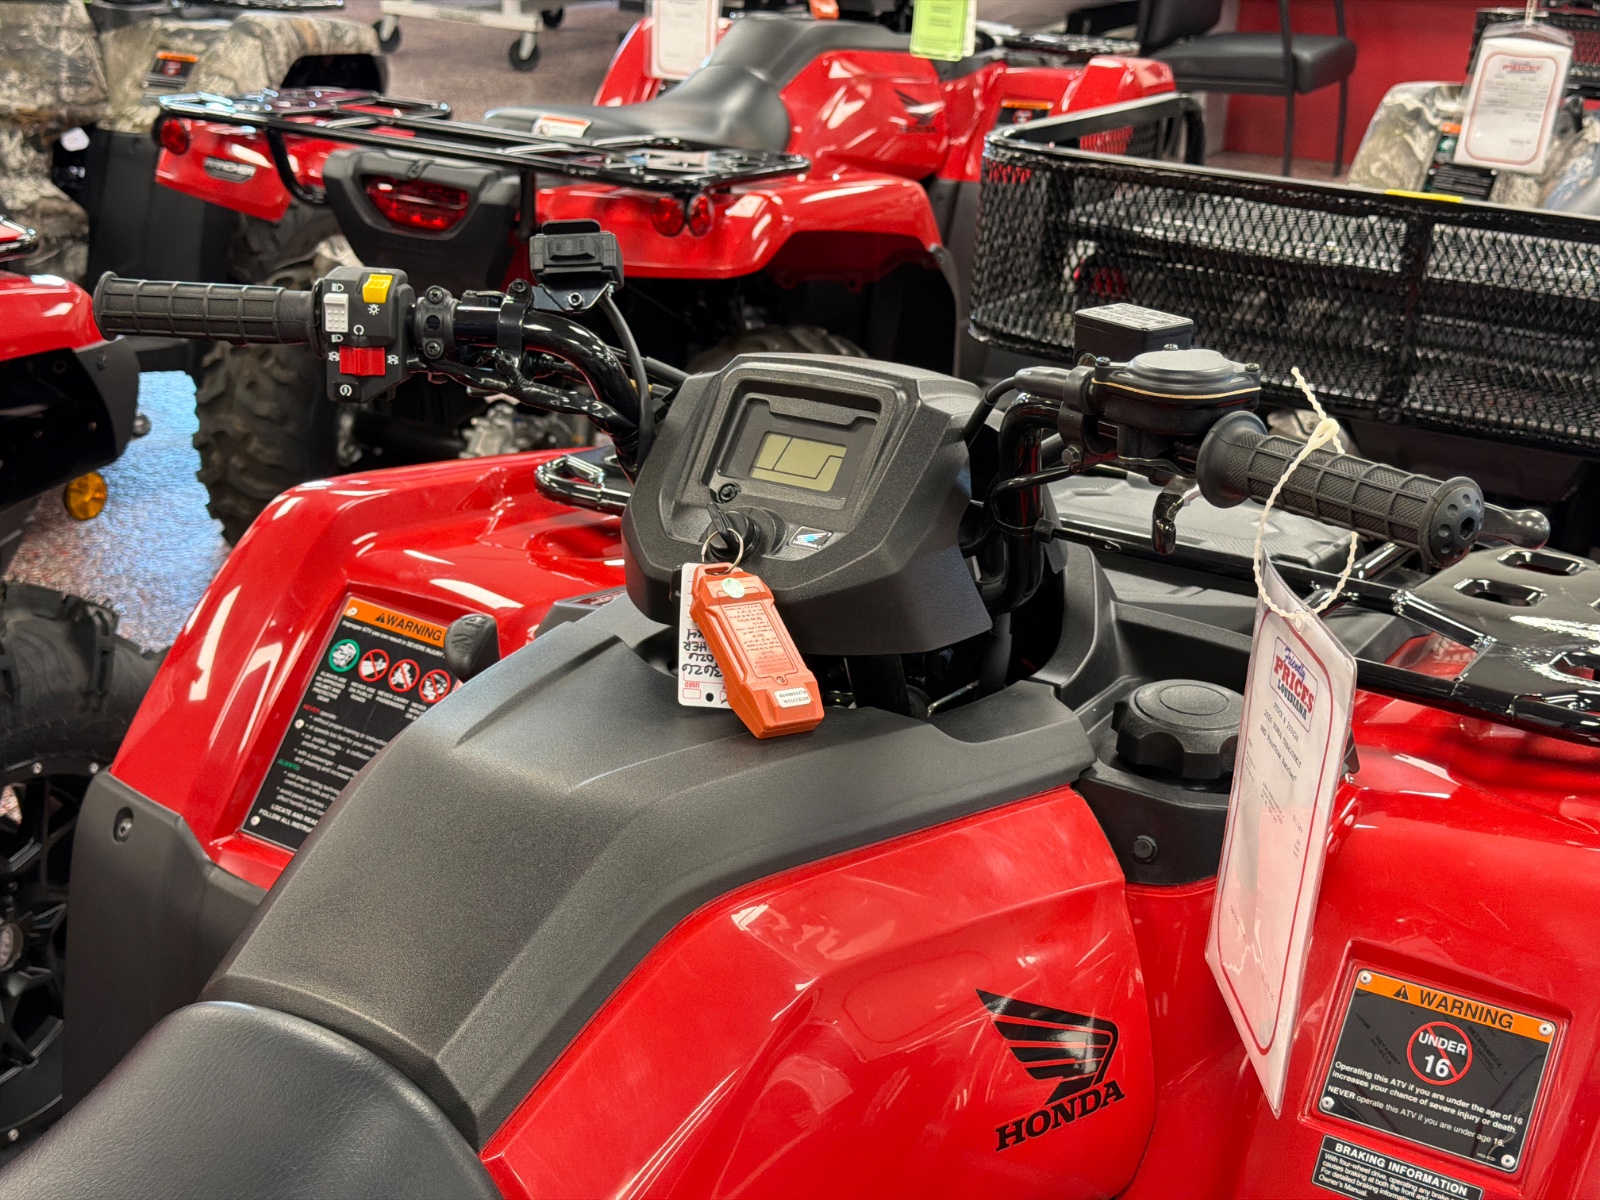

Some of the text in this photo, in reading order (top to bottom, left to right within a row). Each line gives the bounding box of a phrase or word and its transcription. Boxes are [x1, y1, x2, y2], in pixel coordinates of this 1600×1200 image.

[386, 614, 443, 641] WARNING
[1284, 646, 1306, 682] Friendly
[1274, 655, 1314, 714] PRICES
[1277, 678, 1307, 720] LOUISIANA
[258, 808, 281, 821] FOLLOW
[280, 817, 291, 826] ALL
[270, 803, 292, 816] LOCATE
[291, 811, 304, 820] AND
[1420, 990, 1514, 1030] WARNING
[1418, 1032, 1467, 1055] UNDER
[1424, 1054, 1450, 1078] 16
[1335, 1061, 1372, 1079] Operating
[1374, 1073, 1388, 1084] this
[1390, 1078, 1407, 1089] ATV
[1408, 1083, 1415, 1091] if
[1415, 1087, 1430, 1096] you
[1431, 1092, 1445, 1101] are
[1446, 1096, 1470, 1108] under
[1471, 1103, 1485, 1113] the
[1485, 1109, 1501, 1118] age
[1513, 1116, 1524, 1125] 16
[1369, 1082, 1389, 1093] your
[1389, 1088, 1418, 1103] chance
[1419, 1097, 1429, 1106] of
[1429, 1101, 1456, 1114] severe
[1457, 1108, 1480, 1123] injury
[1492, 1121, 1517, 1134] death.
[994, 1079, 1126, 1152] HONDA
[1327, 1085, 1505, 1147] NEVER operate this ATV if you are under age 16.
[1318, 1174, 1368, 1197] Owner's Manual.
[1320, 1166, 1379, 1194] For detailed braking
[1322, 1161, 1344, 1172] causes
[1344, 1168, 1367, 1182] braking
[1375, 1179, 1389, 1188] both
[1390, 1183, 1400, 1192] the
[1400, 1187, 1416, 1198] front
[1324, 1153, 1450, 1200] With four-wheel drive, operating any brake
[1334, 1142, 1468, 1196] BRAKING INFORMATION
